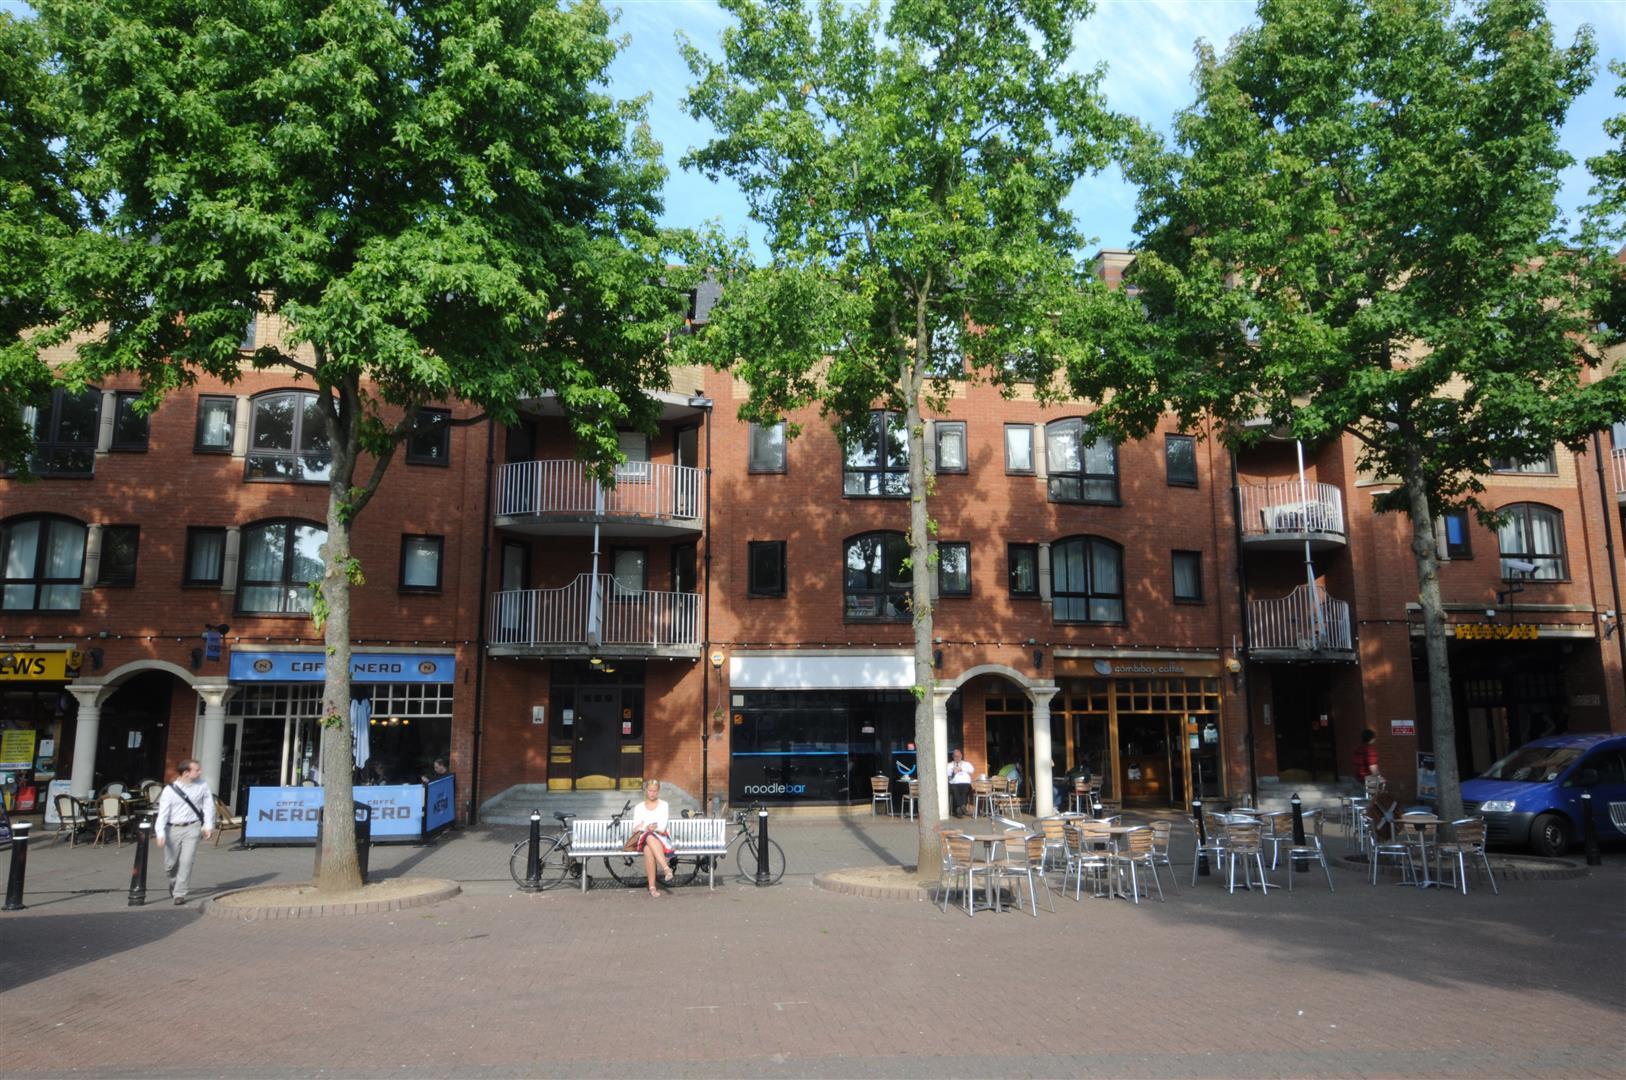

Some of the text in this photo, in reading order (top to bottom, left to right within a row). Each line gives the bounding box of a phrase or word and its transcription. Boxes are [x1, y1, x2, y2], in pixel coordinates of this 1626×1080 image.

[291, 662, 402, 673] CAF NERO
[744, 783, 806, 794] noodlebar
[258, 809, 319, 822] NERO
